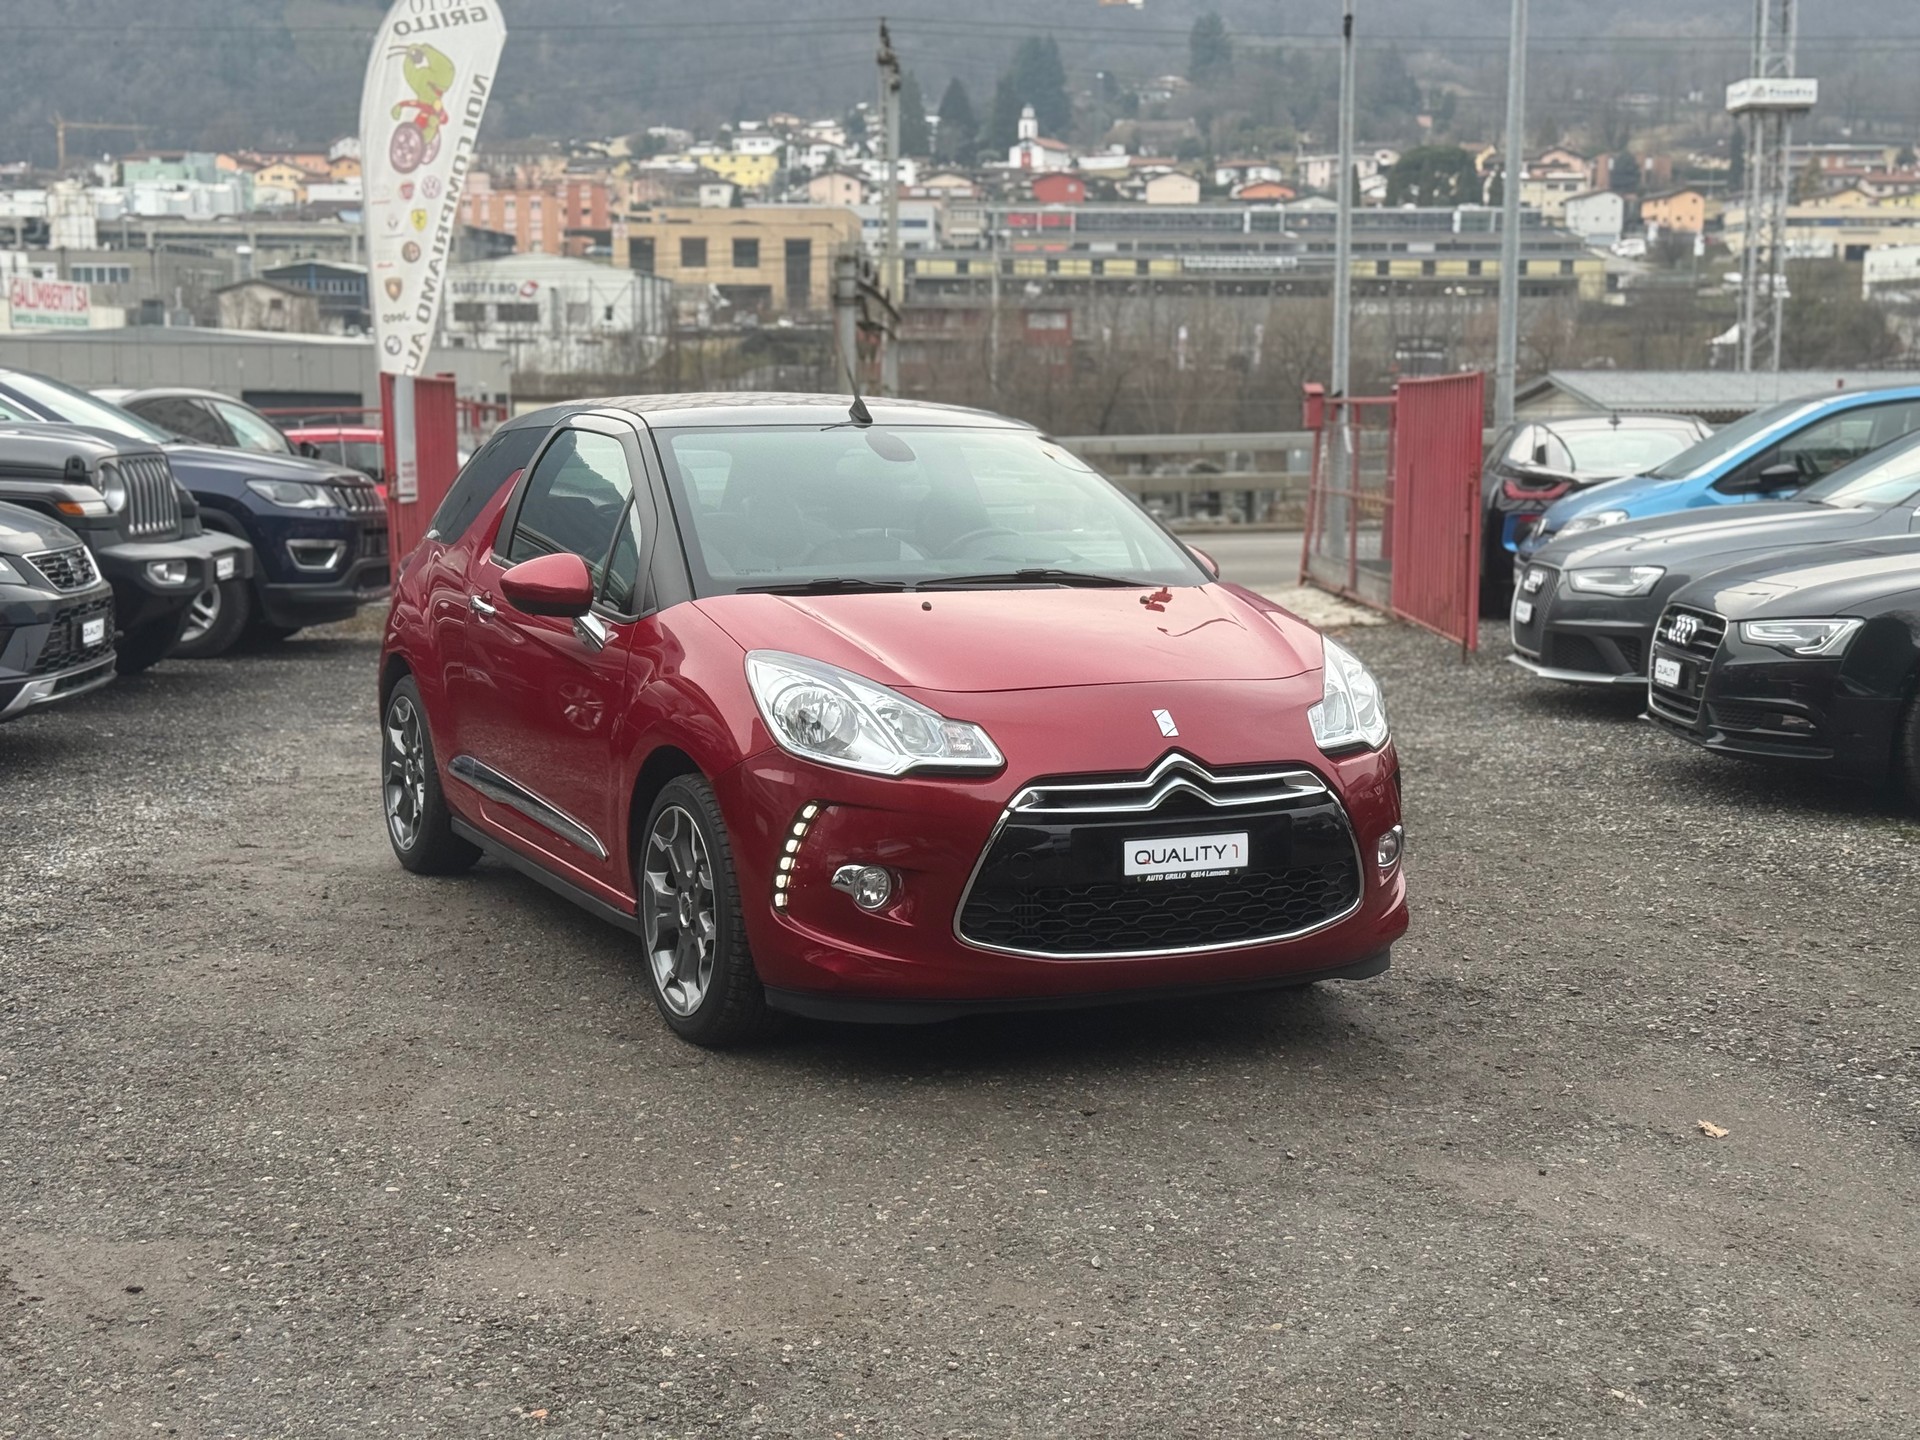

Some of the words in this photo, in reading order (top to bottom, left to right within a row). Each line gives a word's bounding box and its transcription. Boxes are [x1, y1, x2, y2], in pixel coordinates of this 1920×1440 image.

[1134, 844, 1227, 865] QUALITY
[1231, 843, 1239, 858] 1
[1146, 874, 1163, 882] AUTO
[1165, 872, 1187, 880] GRILLO
[1206, 869, 1230, 877] Lamone
